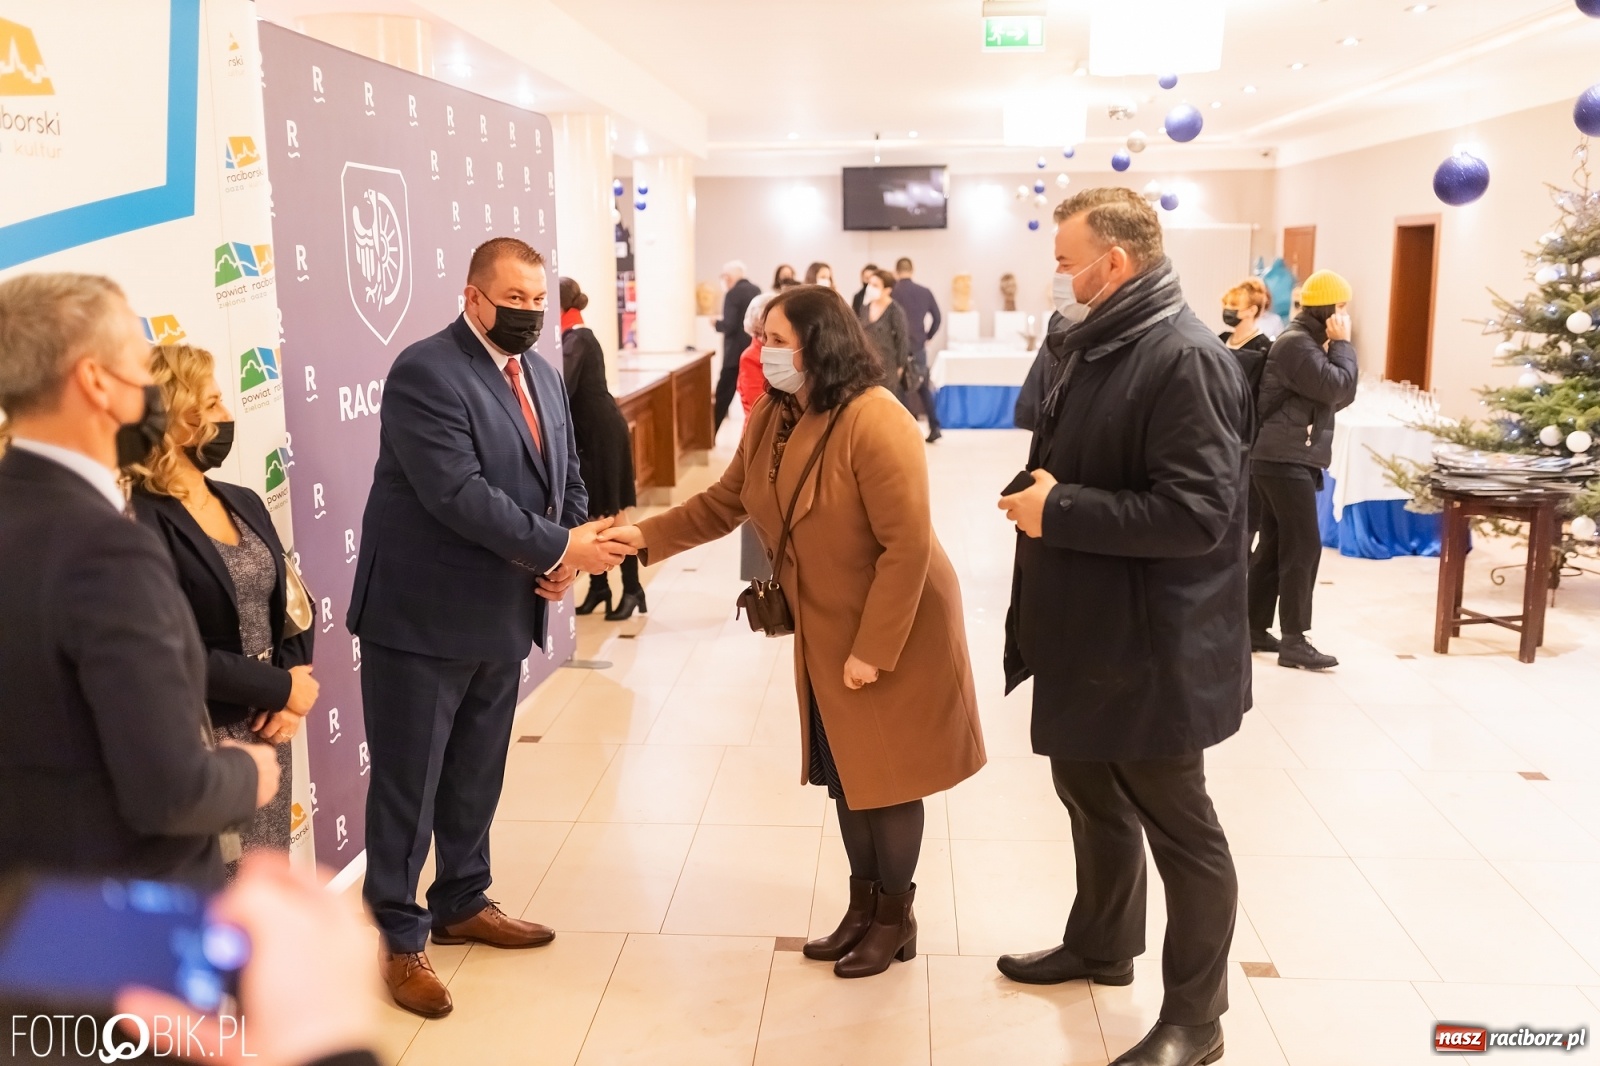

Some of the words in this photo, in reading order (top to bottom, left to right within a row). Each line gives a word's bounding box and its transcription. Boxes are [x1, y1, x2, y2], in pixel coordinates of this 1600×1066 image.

[312, 65, 324, 93] R
[364, 81, 374, 107] R
[408, 94, 417, 118] R
[446, 105, 455, 127] R
[286, 119, 299, 148] R
[480, 114, 487, 135] R
[509, 121, 516, 141] R
[430, 150, 439, 172] R
[466, 156, 473, 177] R
[497, 161, 504, 181] R
[452, 201, 460, 222] R
[484, 204, 492, 224] R
[513, 206, 520, 225] R
[295, 244, 308, 271] R
[436, 248, 445, 269] R
[216, 284, 247, 302] powiat
[304, 365, 317, 391] R
[241, 388, 271, 407] powiat
[313, 483, 325, 509] R
[345, 529, 356, 553] R
[321, 597, 333, 623] R
[329, 708, 340, 734] R
[358, 741, 369, 766] R
[335, 815, 348, 841] R
